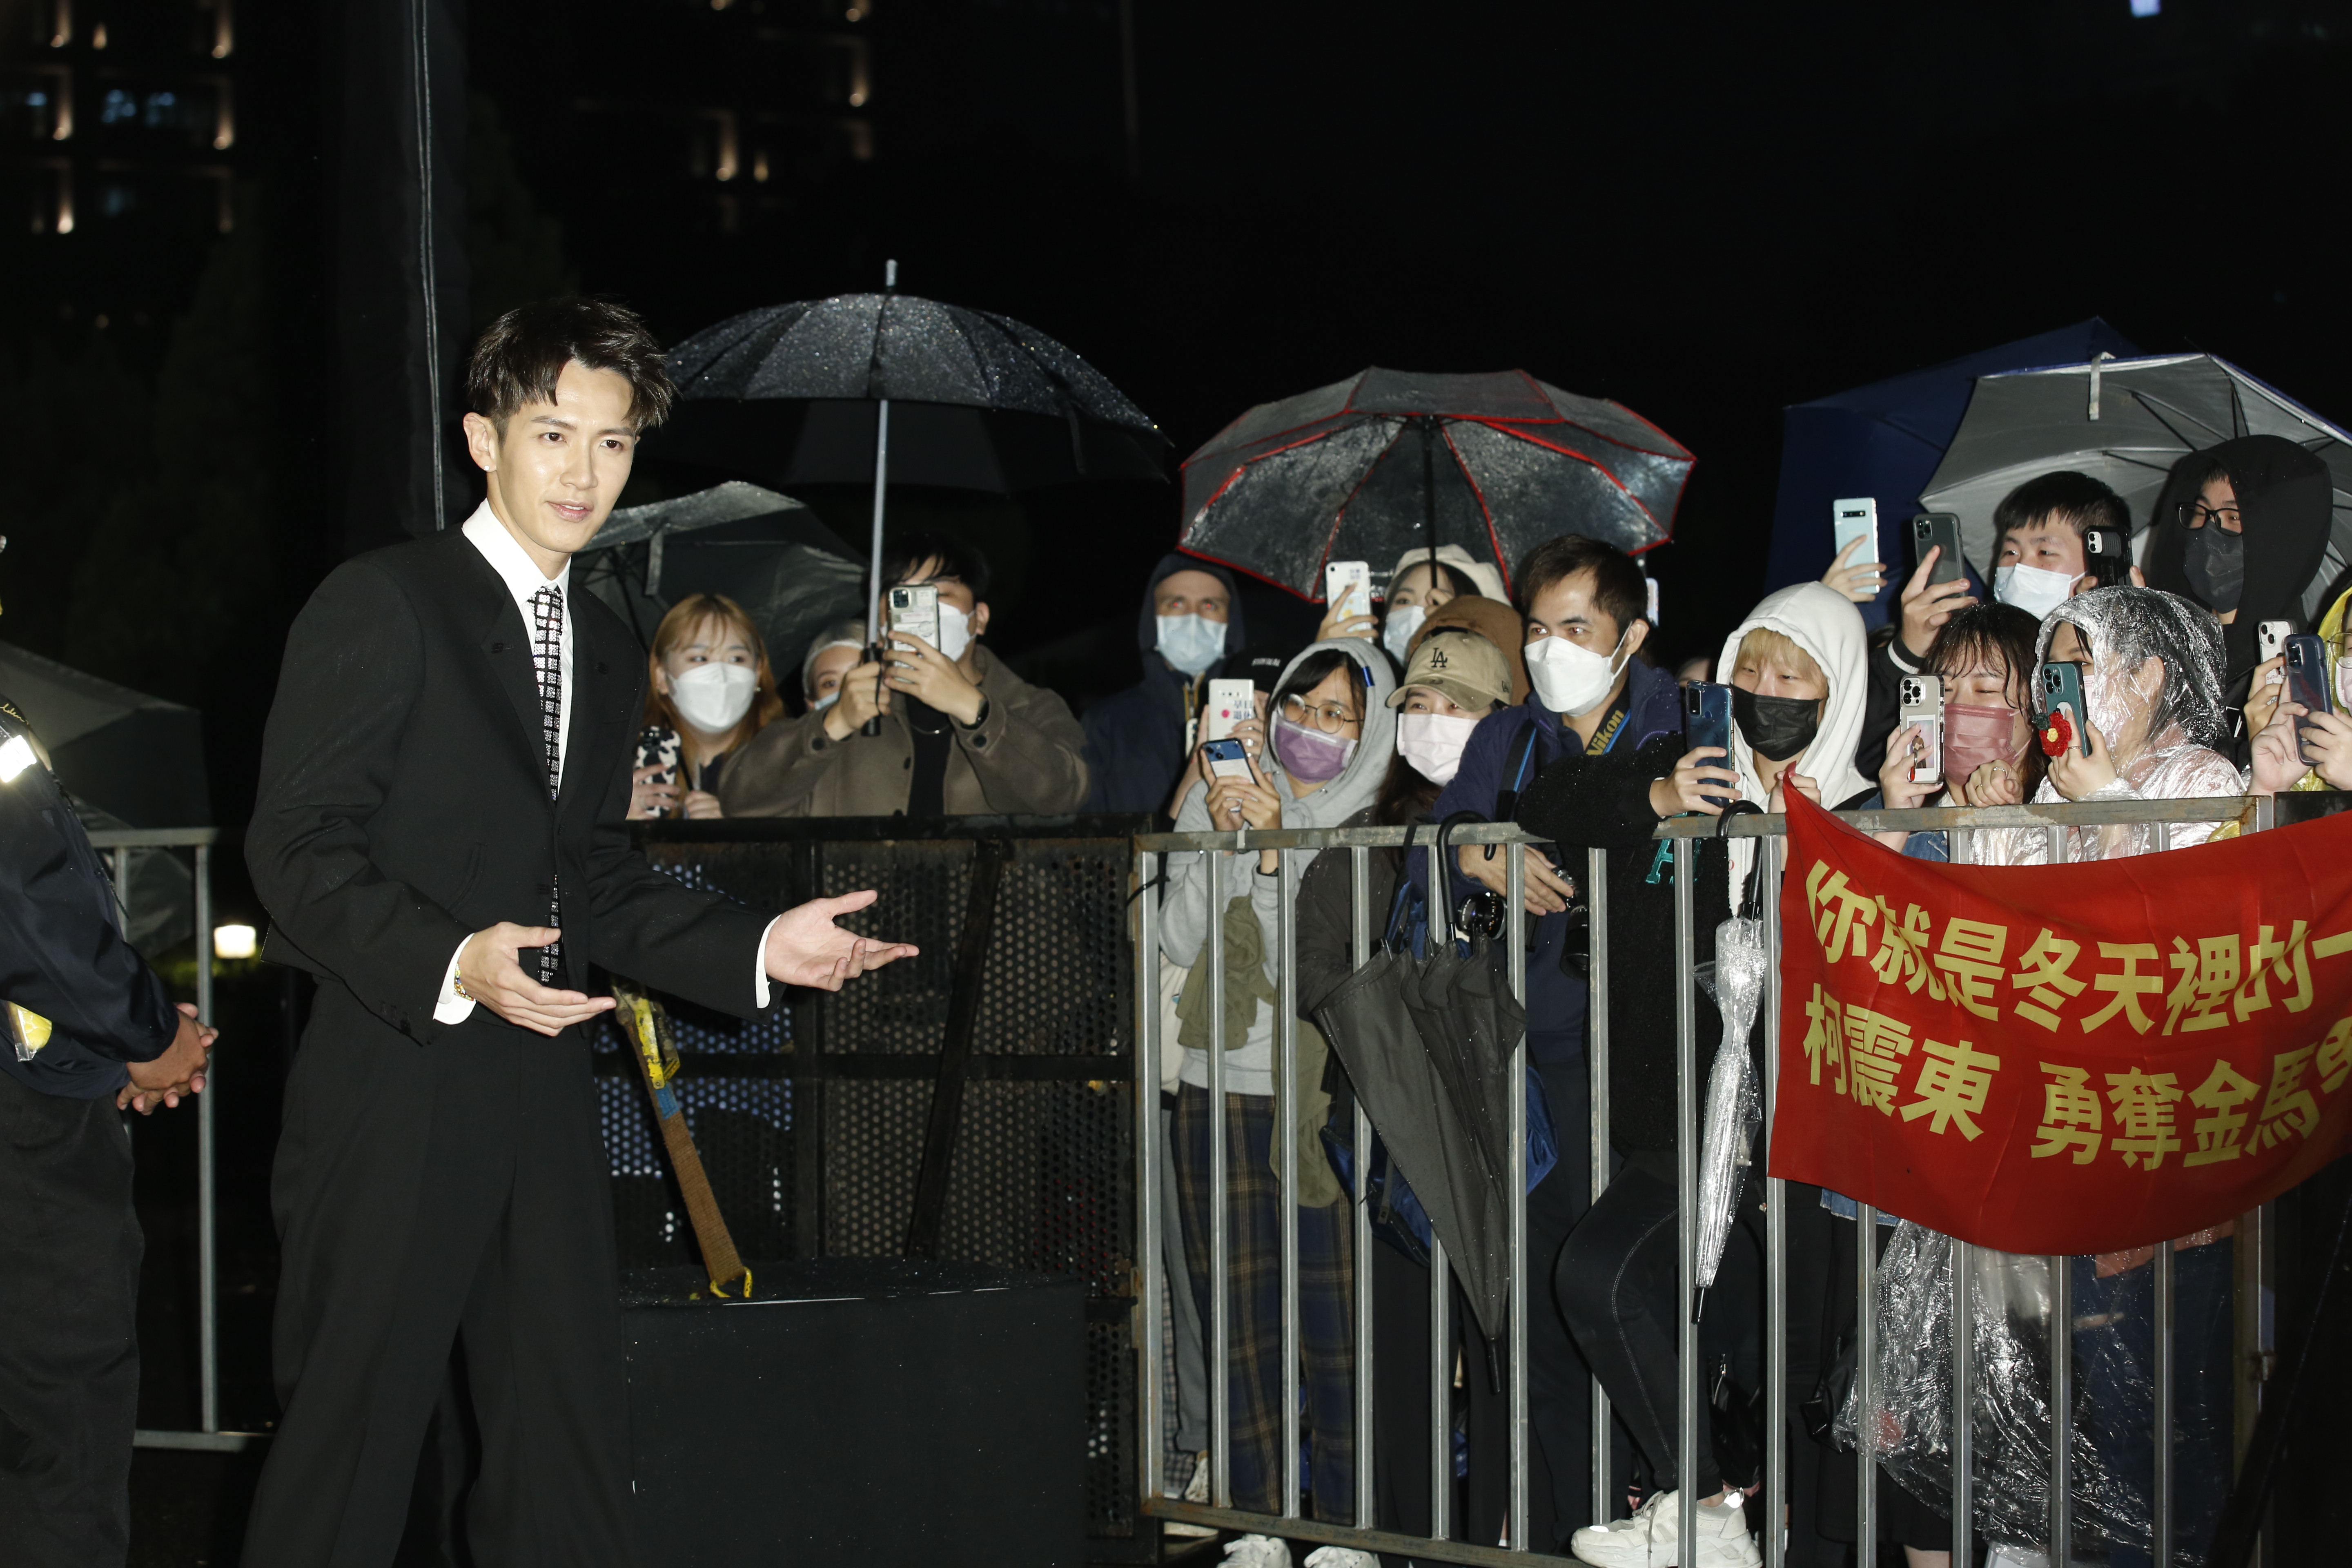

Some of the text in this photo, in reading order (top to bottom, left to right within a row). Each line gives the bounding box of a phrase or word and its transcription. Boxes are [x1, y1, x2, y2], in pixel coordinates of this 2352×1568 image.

[1430, 647, 1448, 668] LA
[1805, 859, 2352, 1036] 你就是冬天裡的一
[1802, 982, 2000, 1142] 柯震東
